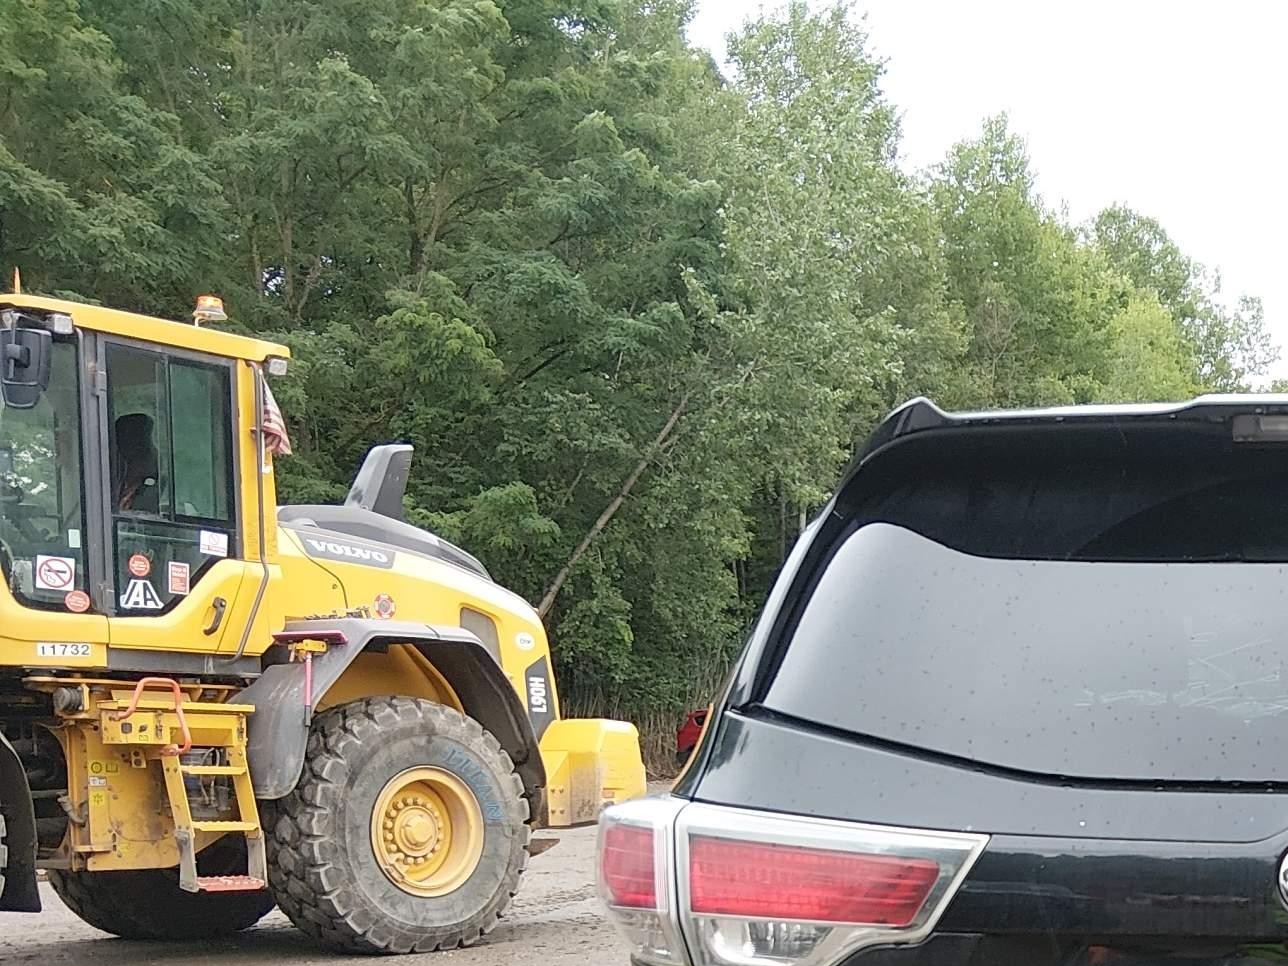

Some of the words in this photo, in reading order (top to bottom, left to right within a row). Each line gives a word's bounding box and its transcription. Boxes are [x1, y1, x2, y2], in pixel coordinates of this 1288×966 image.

[306, 538, 388, 563] VOLVO
[41, 644, 90, 656] 11732
[529, 676, 548, 713] L90H
